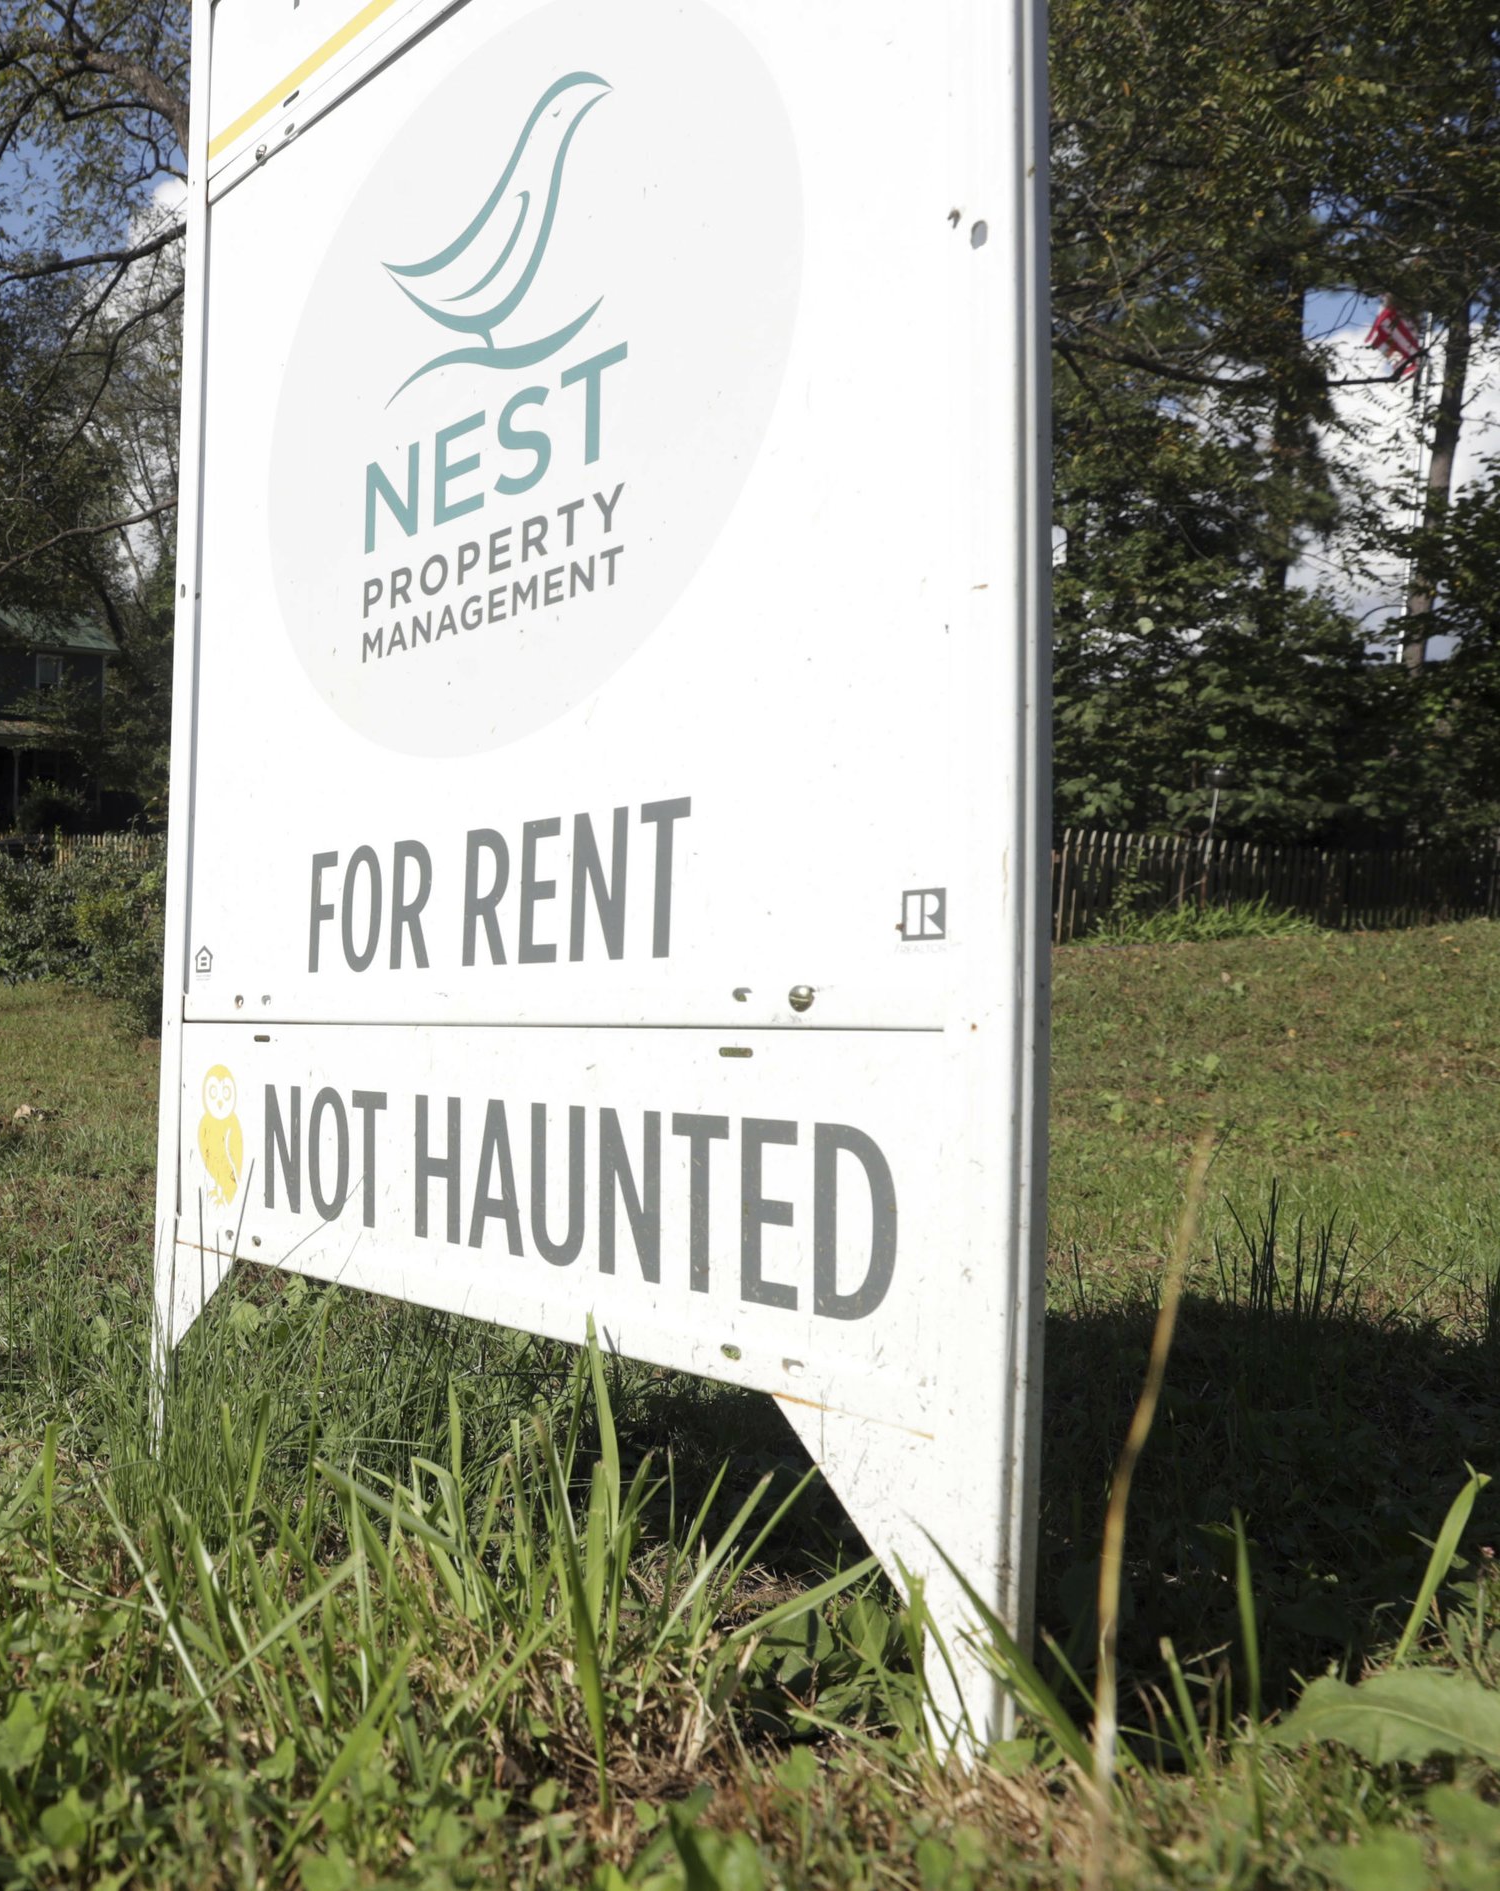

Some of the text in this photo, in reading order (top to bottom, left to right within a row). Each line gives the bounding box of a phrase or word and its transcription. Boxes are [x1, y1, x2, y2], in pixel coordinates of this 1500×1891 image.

[364, 341, 628, 554] NEST
[362, 544, 624, 663] MANAGEMENT
[363, 482, 625, 619] PROPERTY
[308, 796, 692, 973] FOR RENT
[263, 1083, 898, 1321] NOT HAUNTED
